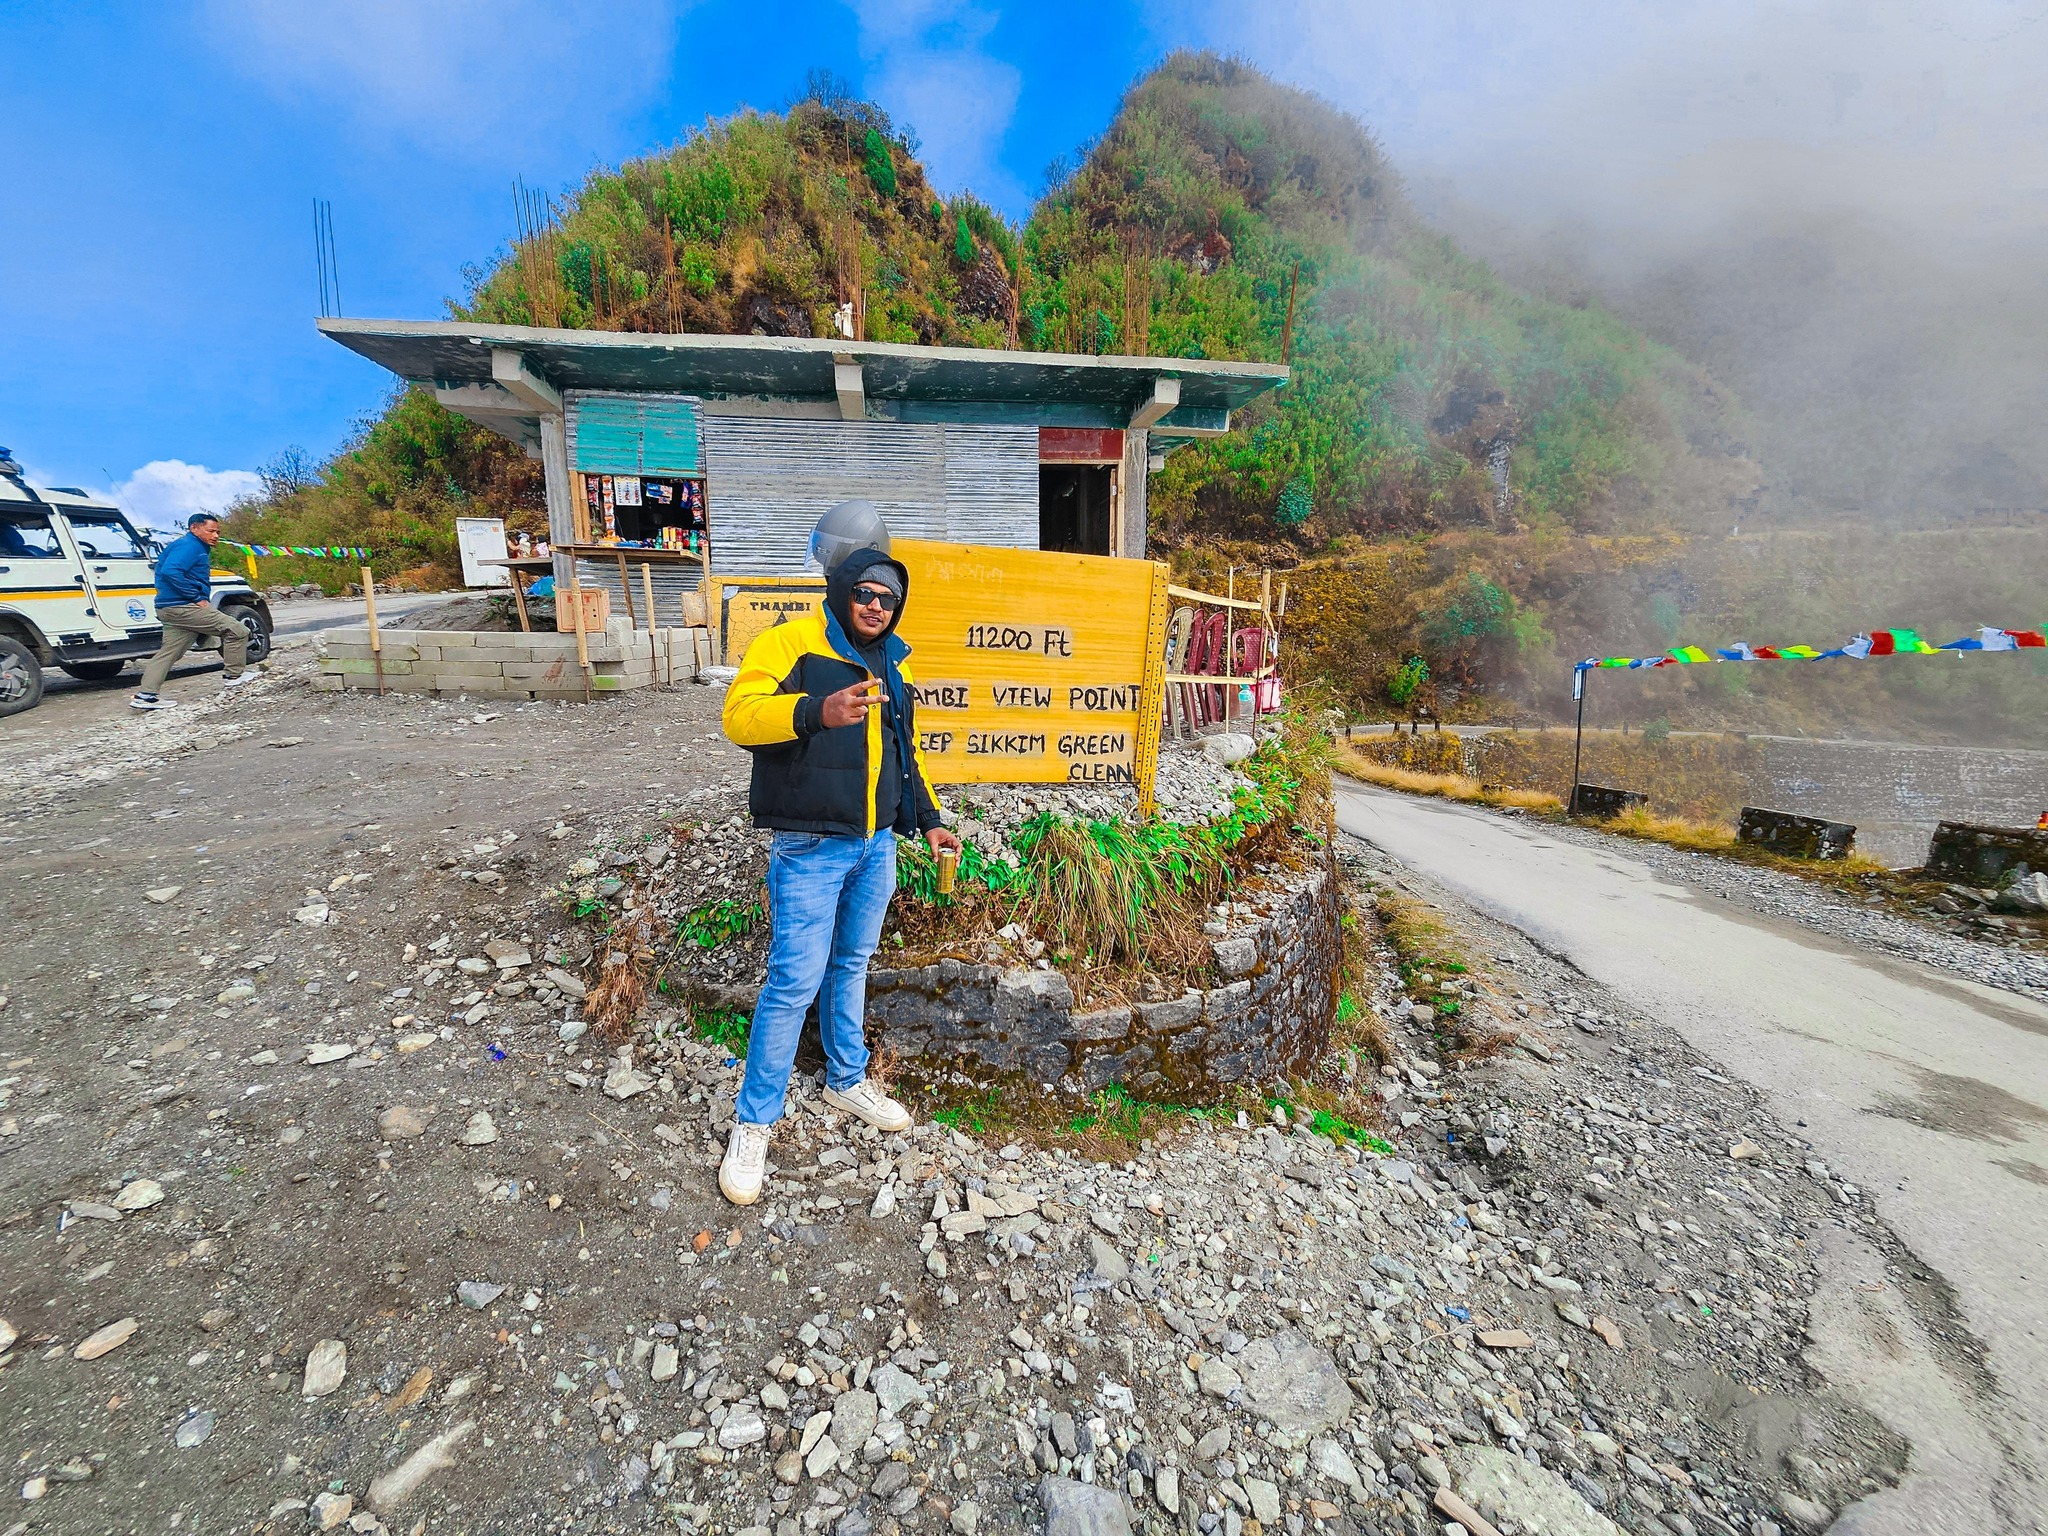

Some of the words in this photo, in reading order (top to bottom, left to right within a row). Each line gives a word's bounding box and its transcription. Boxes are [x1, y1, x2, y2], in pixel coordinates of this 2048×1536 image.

[965, 625, 1033, 651] 11200
[1044, 630, 1072, 657] Ft
[914, 686, 969, 708] AMBI
[992, 686, 1052, 708] VIEW
[1069, 685, 1141, 711] POINT
[920, 732, 953, 754] EEP
[966, 733, 1045, 754] SIKKIM
[1058, 733, 1125, 758] GREEN
[1069, 761, 1133, 782] CLEAN
